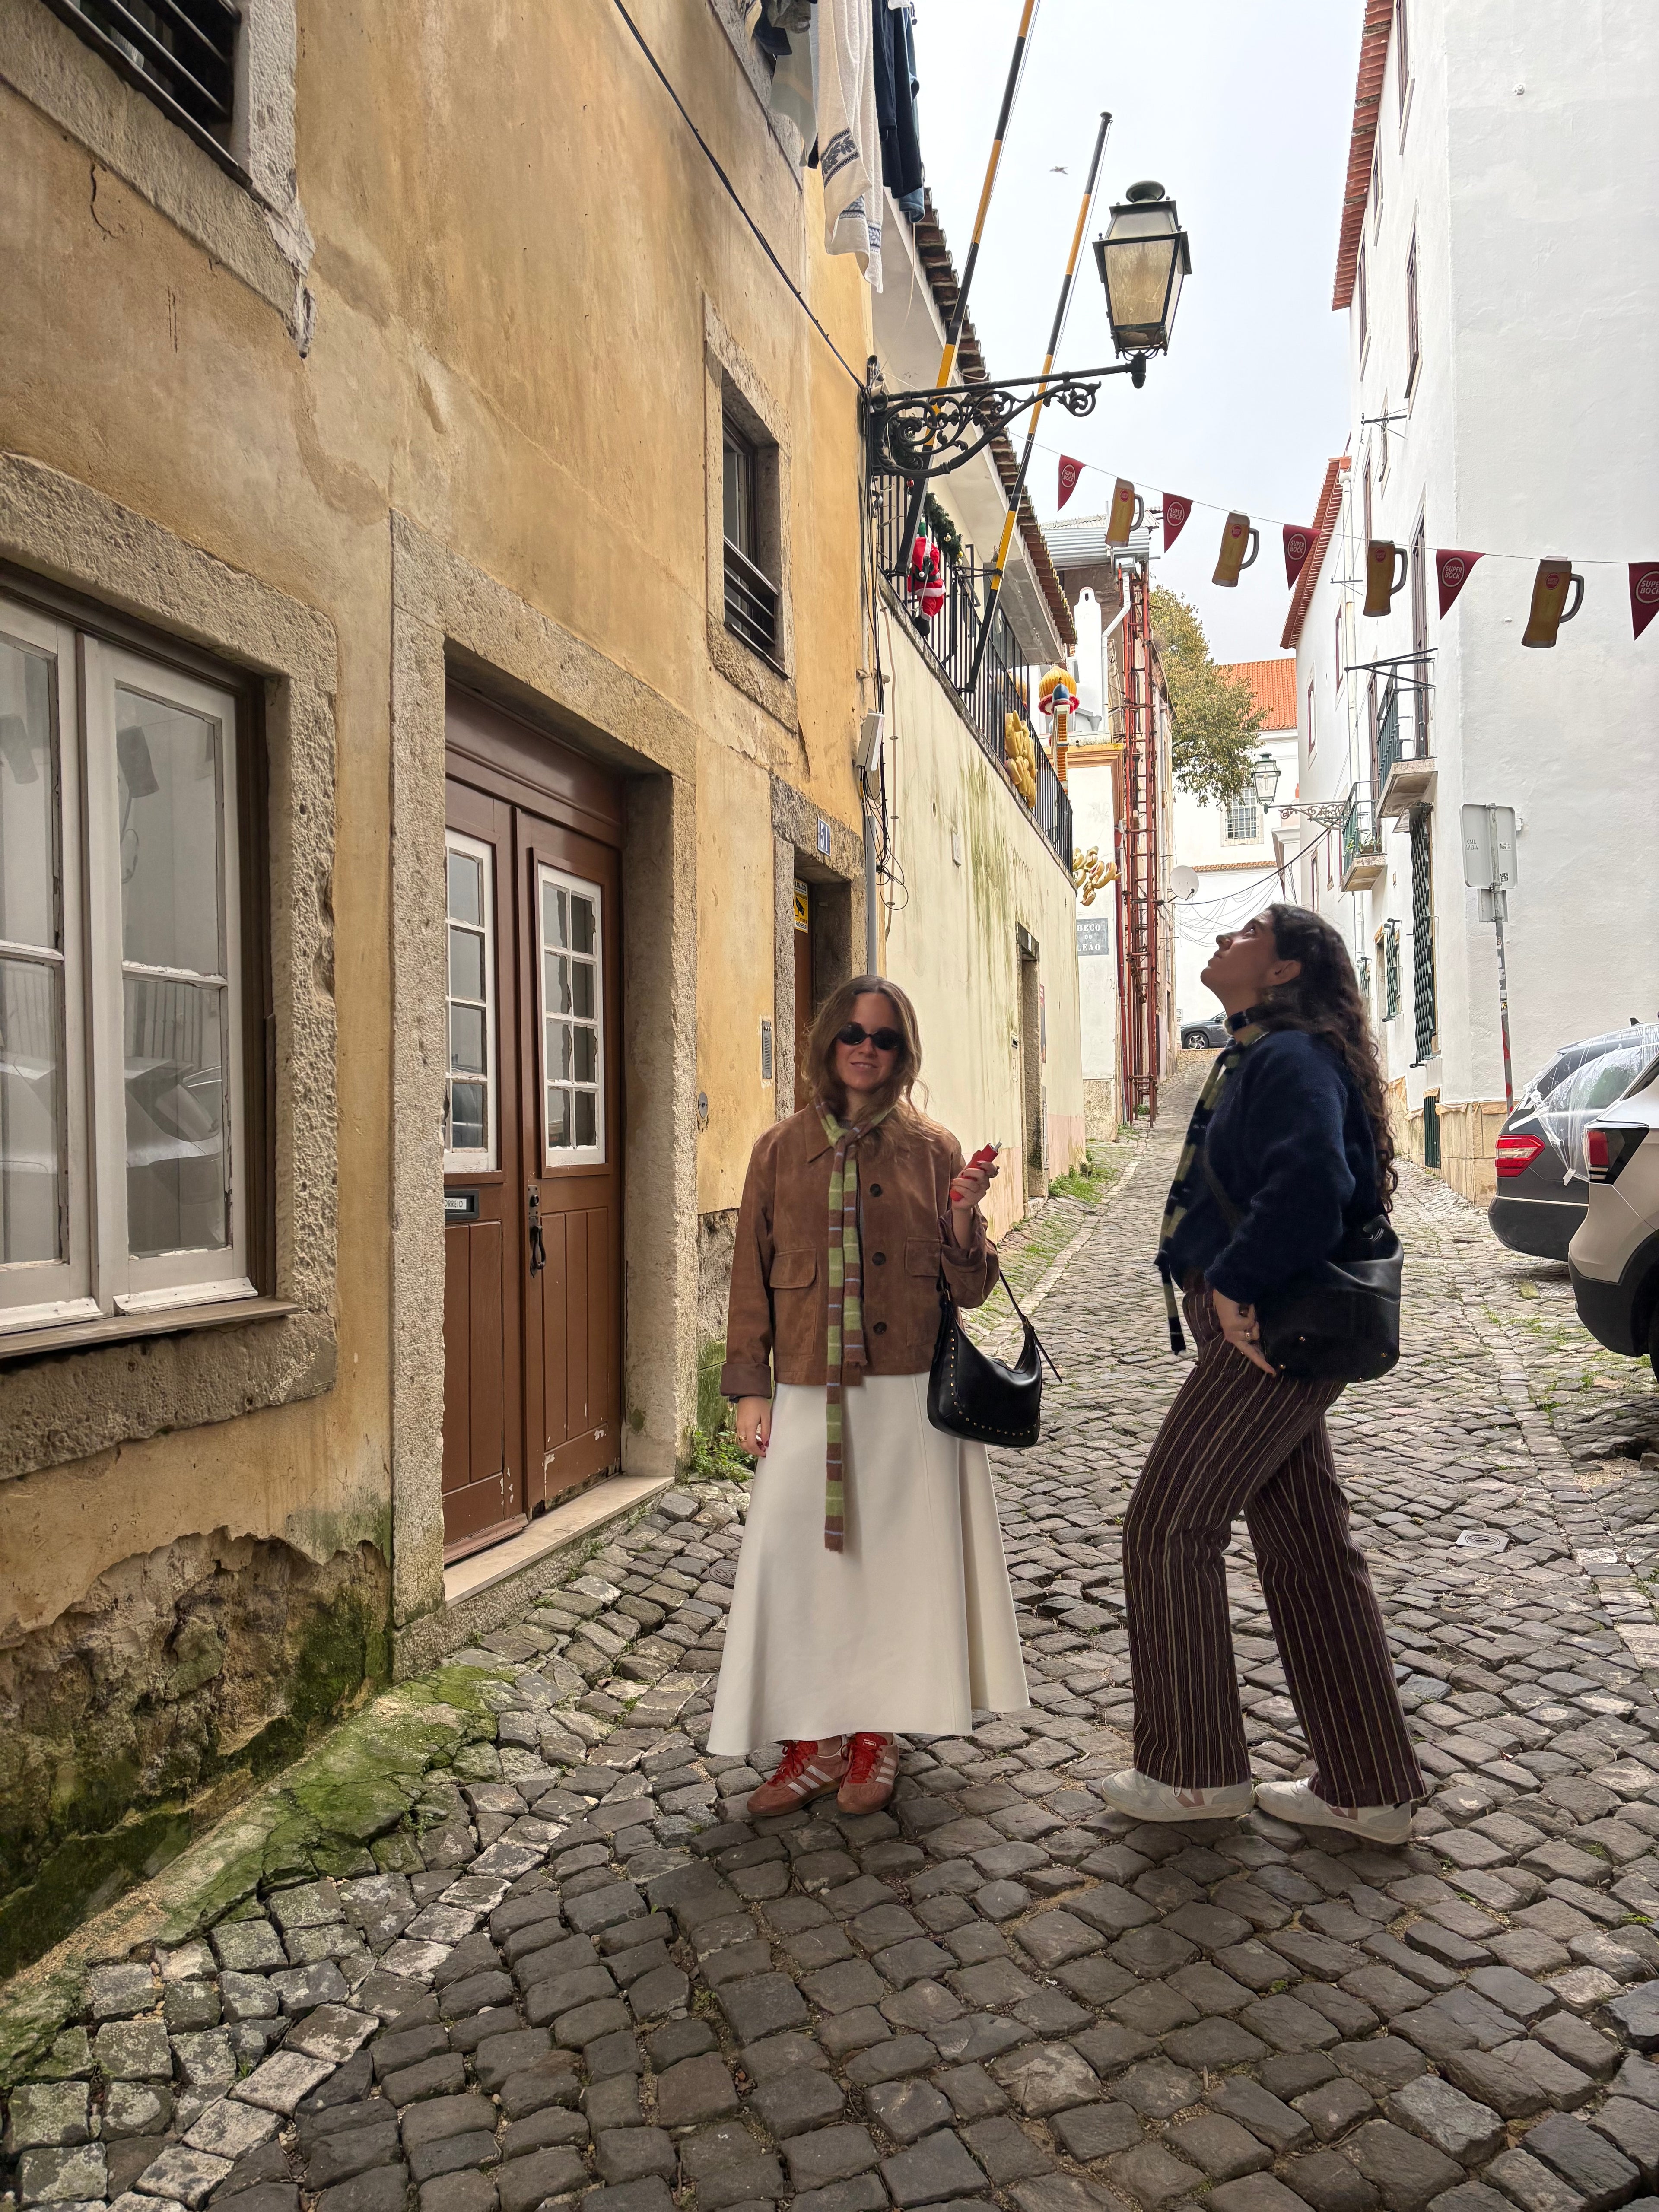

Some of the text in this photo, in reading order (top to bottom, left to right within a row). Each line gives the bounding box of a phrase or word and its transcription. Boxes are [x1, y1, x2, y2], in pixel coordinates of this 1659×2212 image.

[1446, 565, 1462, 574] SUPER
[820, 823, 828, 852] 51
[795, 880, 806, 892] LIGADO
[1077, 942, 1101, 952] LEÃO
[444, 1200, 463, 1208] ORREIO
